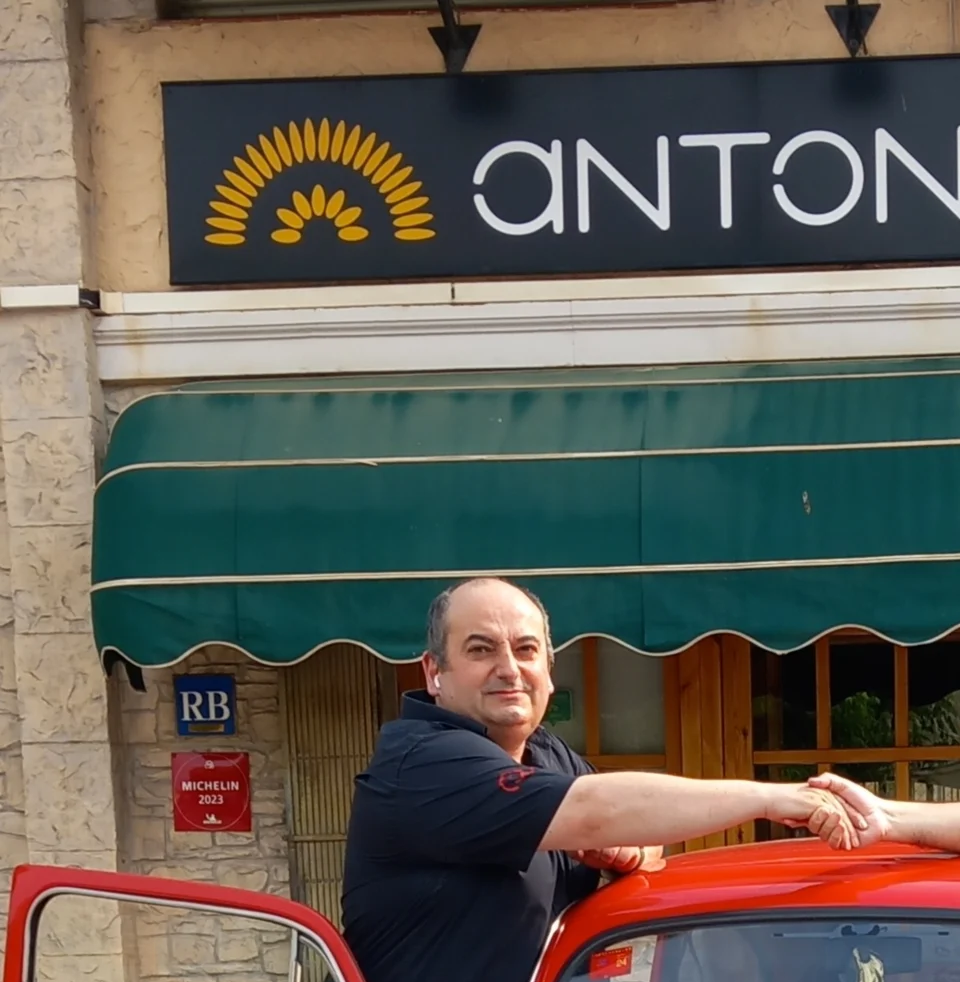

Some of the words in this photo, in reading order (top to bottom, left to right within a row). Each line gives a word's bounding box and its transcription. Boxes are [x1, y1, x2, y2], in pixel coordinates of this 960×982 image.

[180, 690, 230, 722] RB
[182, 780, 239, 791] MICHELIN
[198, 794, 224, 805] 2023
